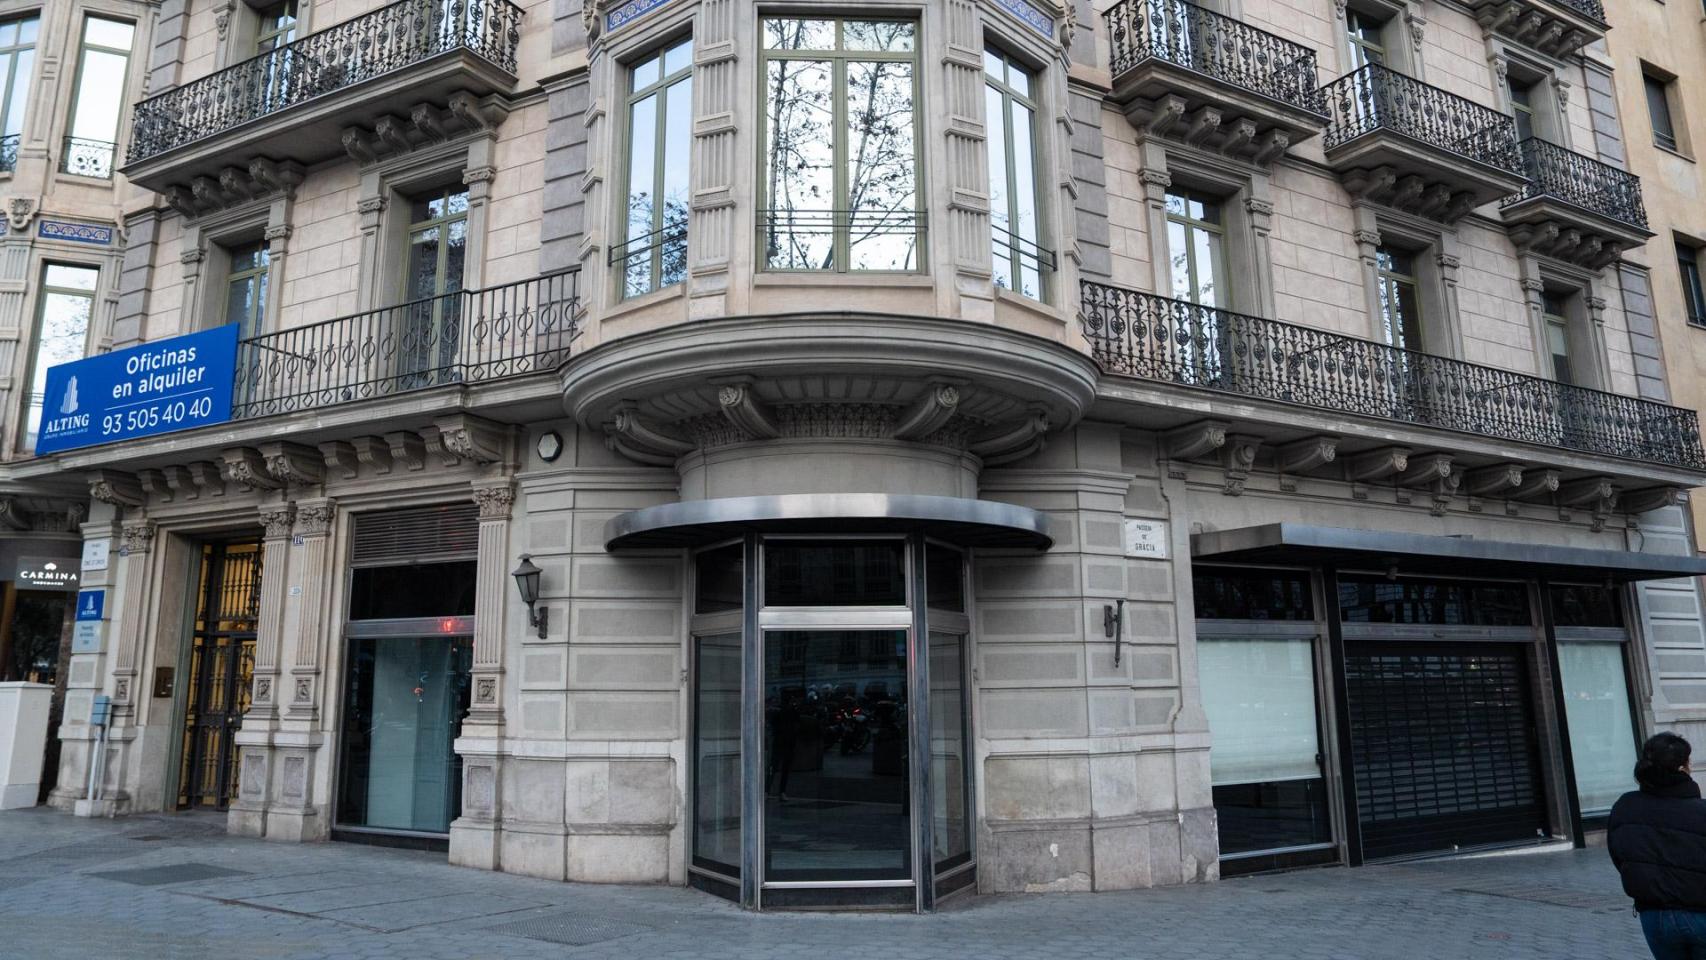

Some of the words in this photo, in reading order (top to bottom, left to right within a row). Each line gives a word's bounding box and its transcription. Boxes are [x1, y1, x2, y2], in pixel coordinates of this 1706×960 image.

[126, 347, 196, 374] Oficinas
[113, 383, 132, 398] en
[138, 366, 206, 394] alquiler
[45, 414, 90, 433] ALTING
[102, 414, 123, 435] 93
[127, 406, 159, 430] 505
[162, 402, 185, 423] 40
[189, 396, 212, 418] 40
[20, 570, 77, 580] CARMINA
